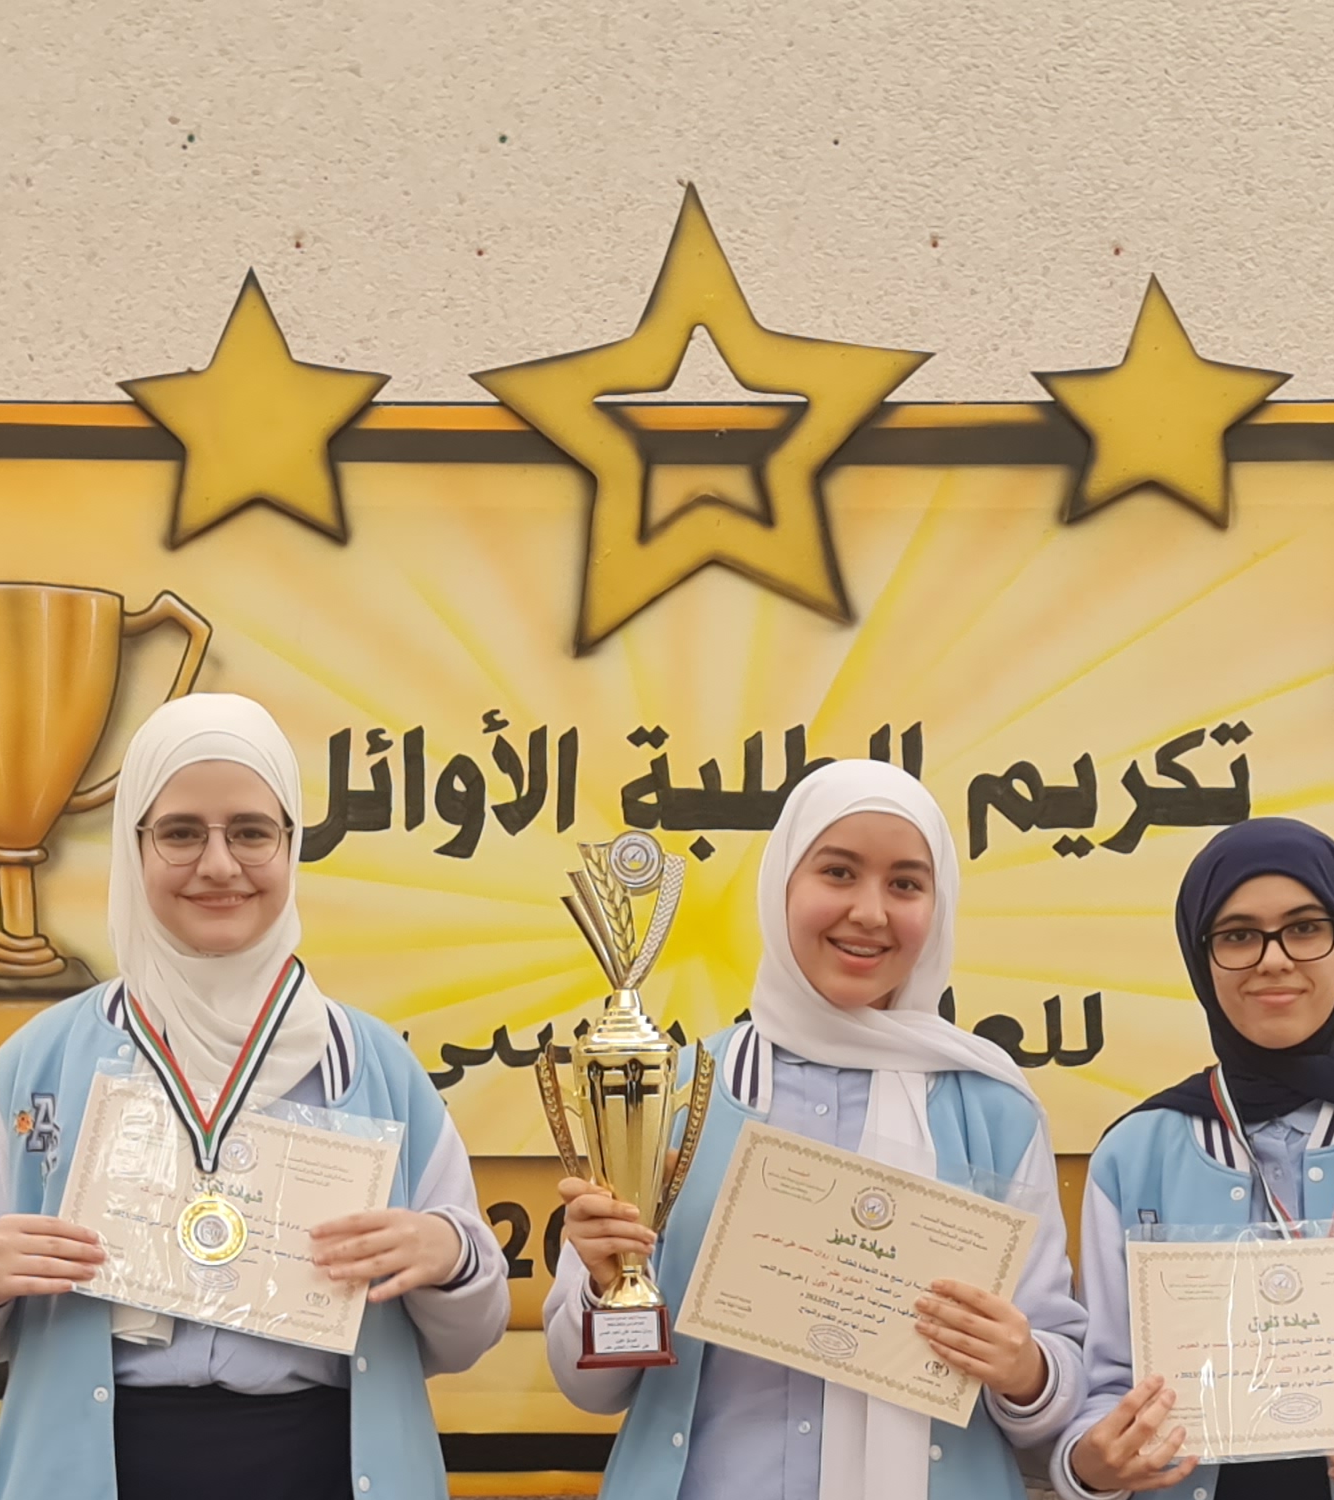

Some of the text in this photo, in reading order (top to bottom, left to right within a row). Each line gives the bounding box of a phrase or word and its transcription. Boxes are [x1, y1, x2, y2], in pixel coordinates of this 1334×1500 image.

[299, 709, 579, 862] الأوائل
[967, 720, 1253, 860] تكريم
[826, 1228, 896, 1259] شهادة تميز
[1283, 1312, 1320, 1329] شهادة
